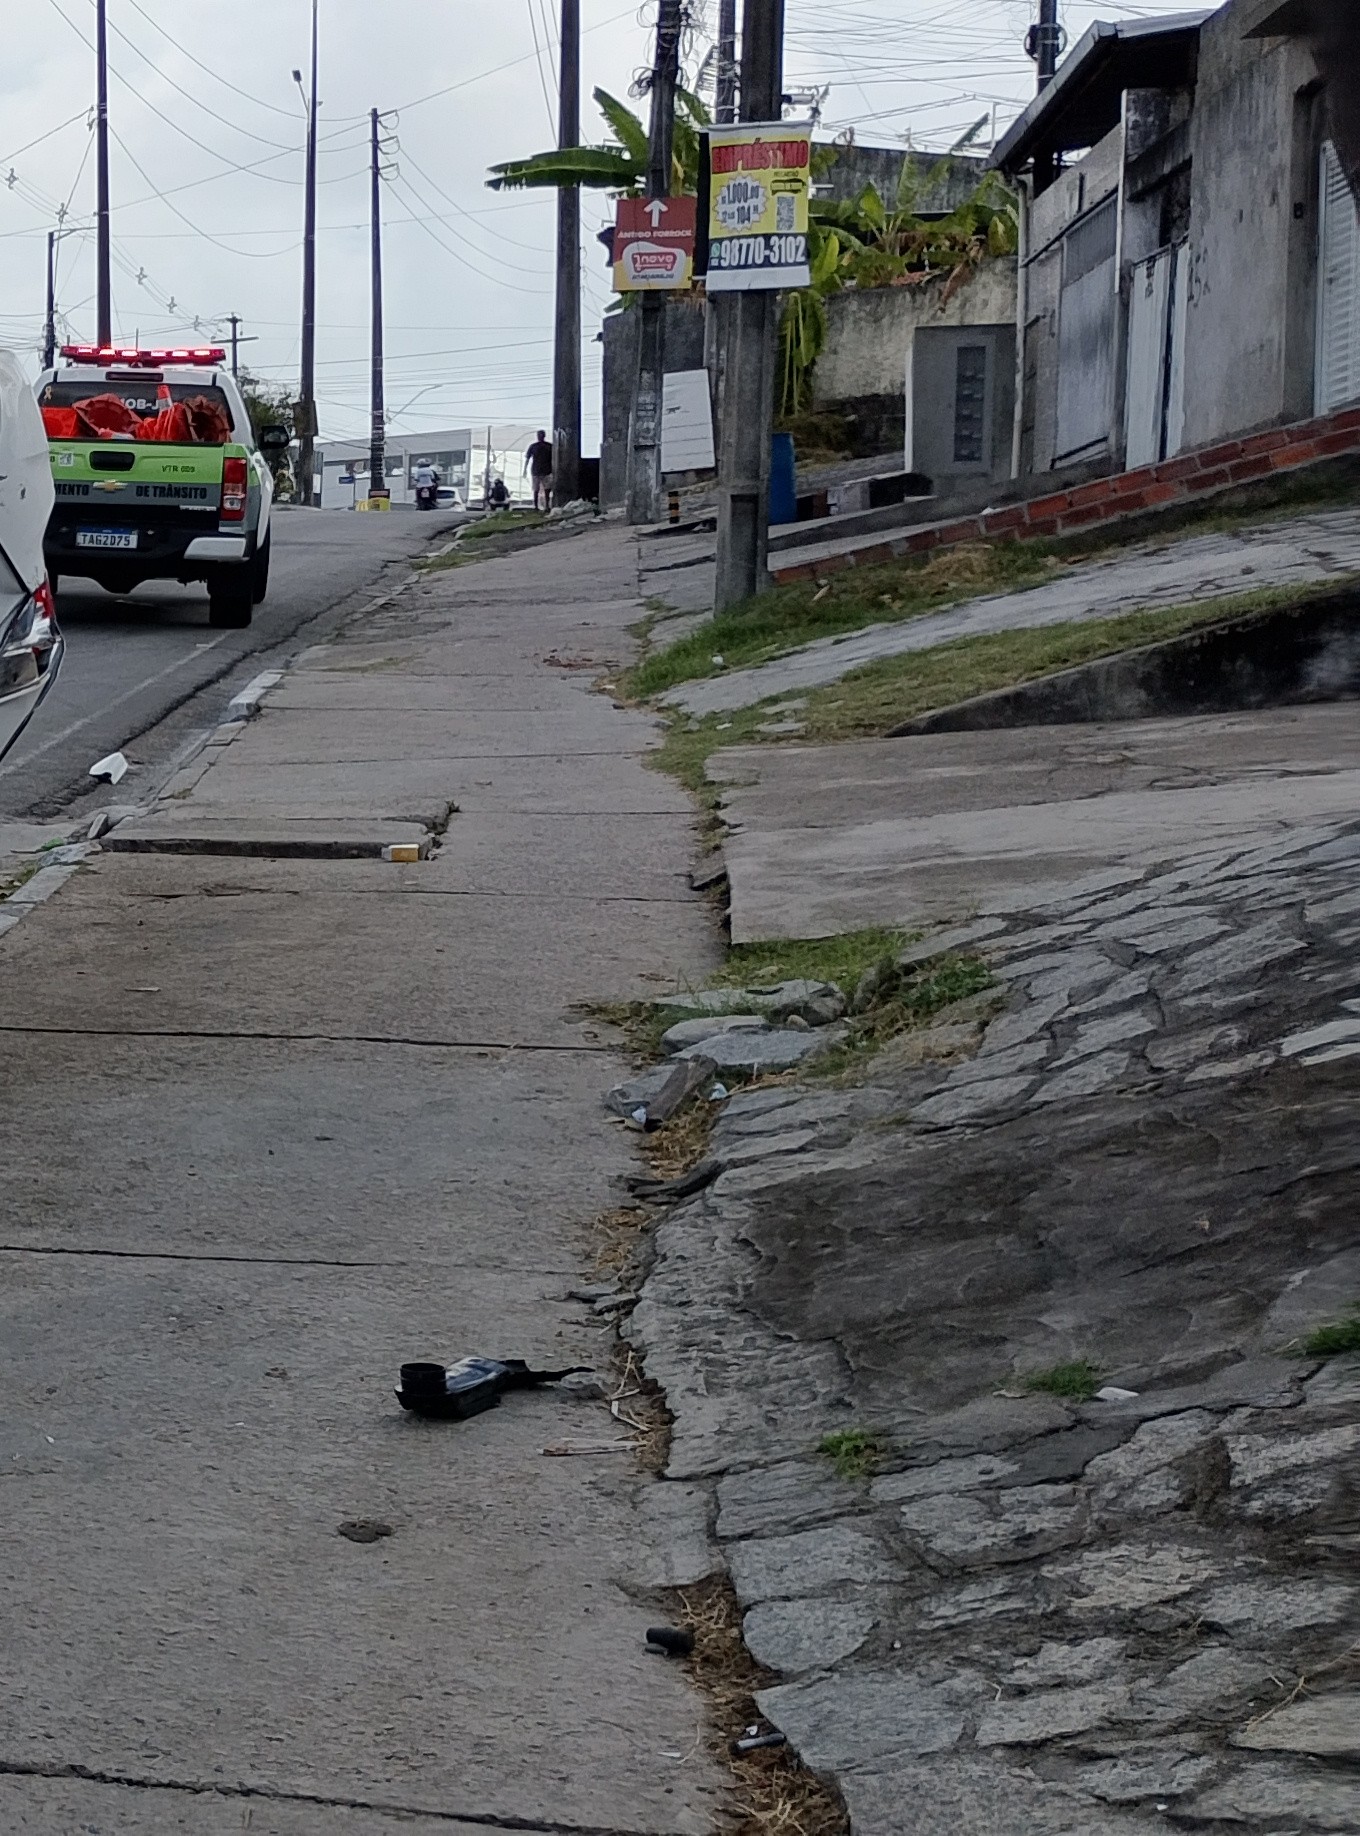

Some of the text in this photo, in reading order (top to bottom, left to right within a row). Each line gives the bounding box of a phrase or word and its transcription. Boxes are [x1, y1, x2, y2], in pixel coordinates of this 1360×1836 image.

[711, 138, 809, 174] EMPRÉSTIMO
[617, 229, 692, 239] ANTIGO FORROCK
[721, 236, 806, 267] 98770-3102
[136, 485, 150, 497] DE
[152, 483, 207, 499] TRÂNSITO
[81, 534, 130, 547] TAG2D75
